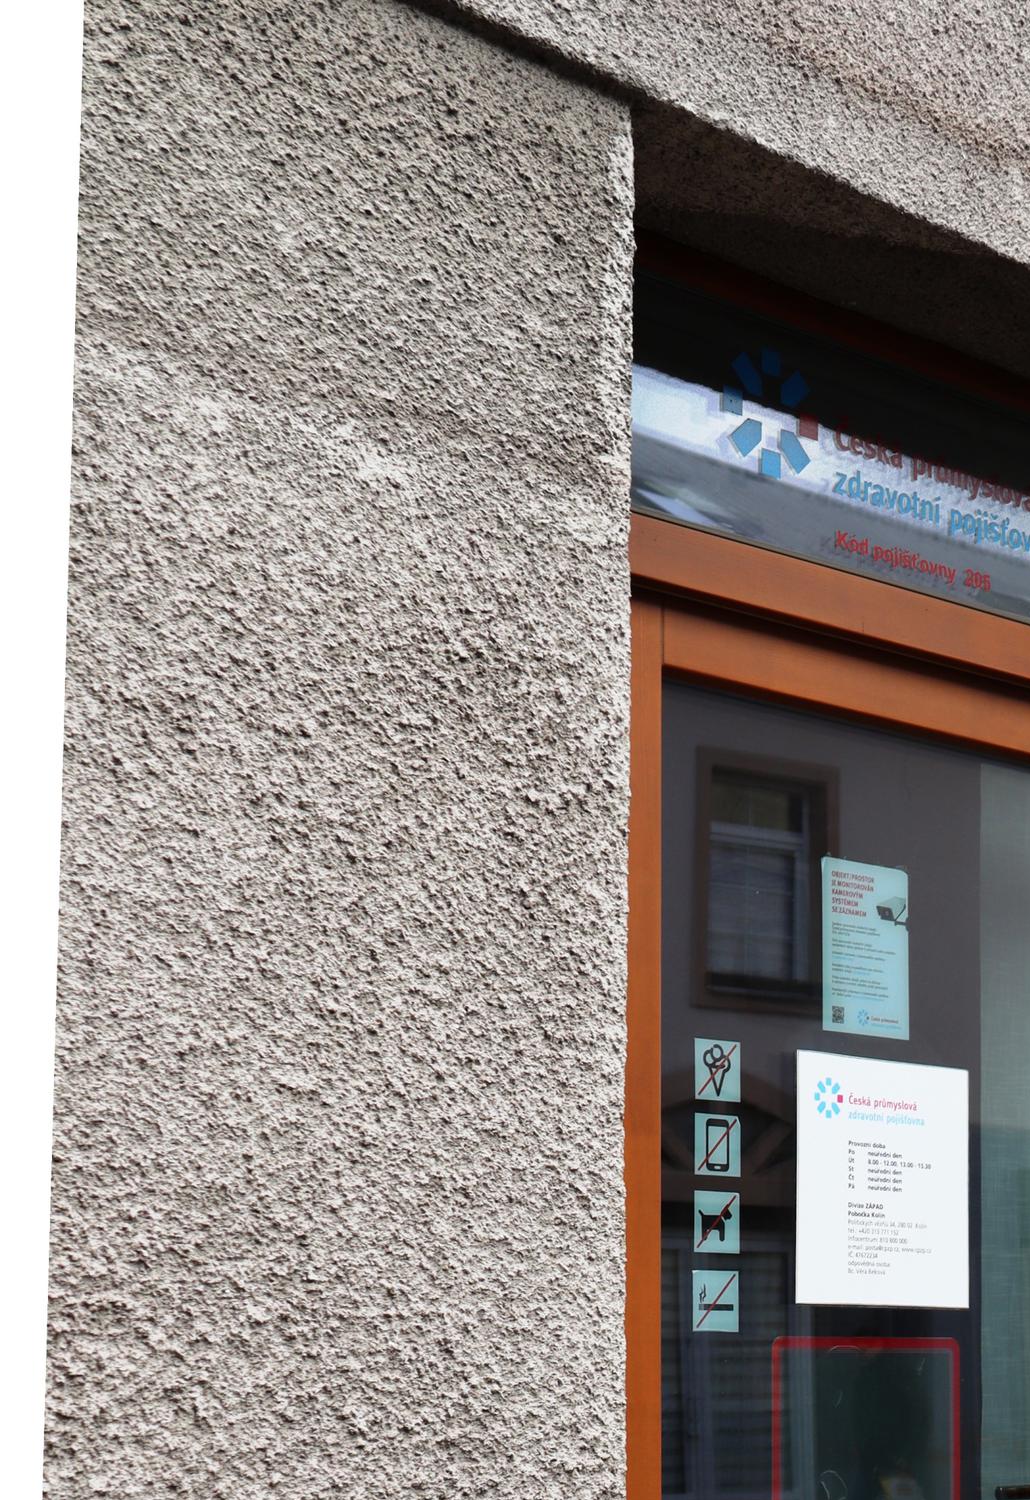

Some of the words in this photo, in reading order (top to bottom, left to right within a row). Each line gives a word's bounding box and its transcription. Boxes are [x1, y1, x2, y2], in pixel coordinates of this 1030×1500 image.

[832, 470, 941, 528] zdravotní
[834, 529, 869, 556] Kód
[872, 544, 957, 585] pojišťovny
[848, 1092, 871, 1107] Česká
[873, 1098, 918, 1112] průmyslová
[848, 1111, 884, 1122] zdravotní
